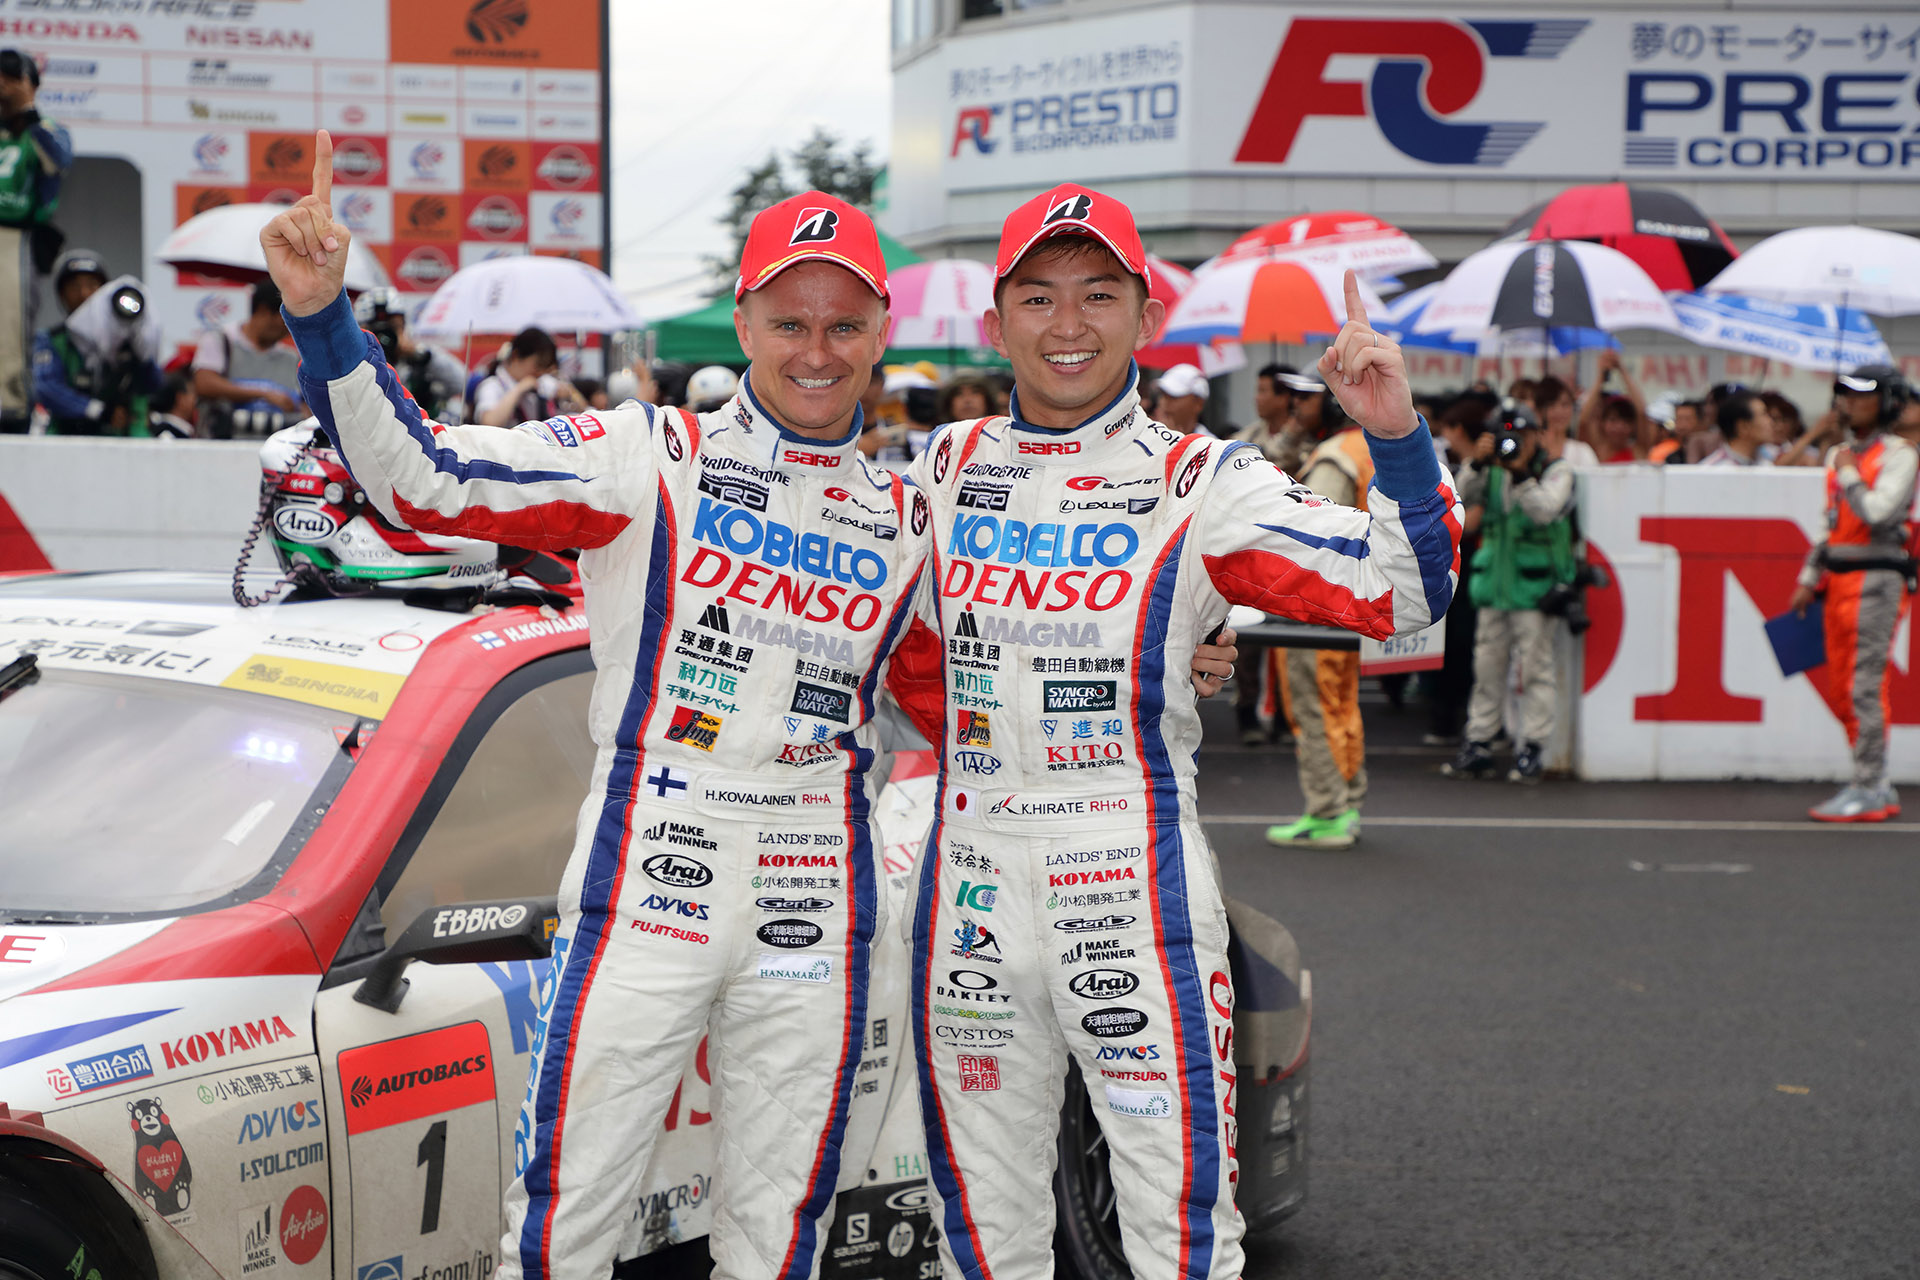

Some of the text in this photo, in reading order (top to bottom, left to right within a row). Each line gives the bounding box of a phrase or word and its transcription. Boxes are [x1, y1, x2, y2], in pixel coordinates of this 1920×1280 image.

[185, 25, 313, 50] NISSAN
[1010, 81, 1179, 133] PRESTO
[1625, 71, 1920, 133] PRE
[704, 482, 766, 508] TRD
[961, 489, 1007, 510] TRD
[1077, 501, 1127, 510] LEXUS
[280, 511, 326, 533] Arai
[834, 514, 873, 532] LEXUS
[692, 497, 888, 591] KOBELCO
[948, 512, 1140, 568] KOBELCO
[681, 546, 883, 632] DENSO
[942, 559, 1133, 612] DENSO
[734, 613, 855, 667] MAGNA
[981, 615, 1104, 649] MAGNA
[1032, 656, 1126, 674] 豊田自動織機
[279, 675, 380, 703] SINGHA
[796, 698, 836, 716] MATIC
[1048, 697, 1093, 709] MATIC
[1044, 742, 1123, 763] KITO
[705, 789, 832, 806] H.KOVALAINEN RH+A
[1021, 801, 1085, 815] K.HIRATE
[669, 822, 705, 838] MAKE
[814, 833, 844, 846] END
[668, 834, 718, 851] WINNER
[758, 854, 838, 868] KOYAMA
[1105, 847, 1142, 859] END
[647, 857, 706, 882] Arai
[1048, 867, 1136, 887] KOYAMA
[762, 876, 842, 889] 小松開発工業
[1058, 889, 1142, 908] 小松開発工業
[433, 904, 527, 938] EBBRO
[631, 920, 709, 945] FUJITSUBO
[770, 936, 808, 945] STM CELL
[1085, 940, 1120, 951] MAKE
[1085, 949, 1136, 962] WINNER
[760, 969, 822, 981] HANAMARU
[1076, 971, 1133, 993] Arai
[937, 986, 1012, 1003] OAKLEY
[936, 1025, 1014, 1041] CVSTOS
[1097, 1025, 1135, 1035] STM CELL
[160, 1016, 297, 1070] KOYAMA
[74, 1048, 152, 1086] 豊田合成
[375, 1054, 487, 1097] AUTOBACS
[1101, 1069, 1168, 1082] FUJITSUBO
[214, 1065, 315, 1101] 小松開発工業
[1108, 1101, 1160, 1116] HANAMARU
[416, 1120, 448, 1236] 1
[247, 1247, 270, 1262] MAKE
[242, 1255, 277, 1274] WINNER
